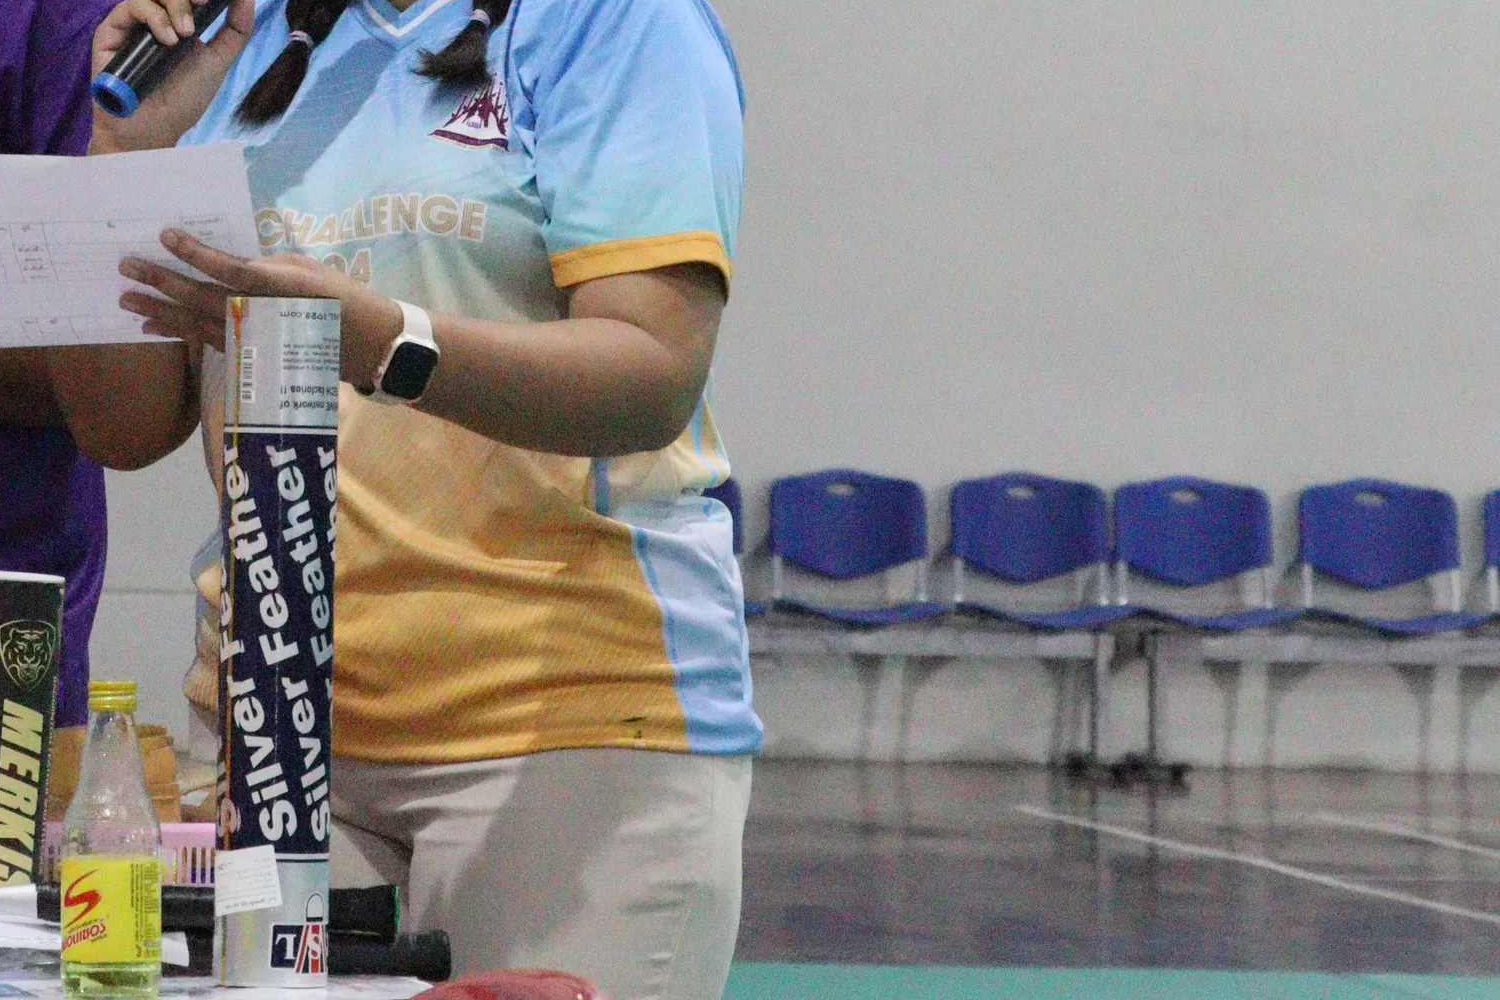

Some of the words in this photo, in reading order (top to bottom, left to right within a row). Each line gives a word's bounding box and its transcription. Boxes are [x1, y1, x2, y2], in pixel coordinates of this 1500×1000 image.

[253, 193, 488, 247] CHALLENGE
[224, 445, 299, 666] Feather
[266, 445, 333, 667] Feather
[226, 675, 297, 842] Silver
[281, 677, 330, 842] Silver
